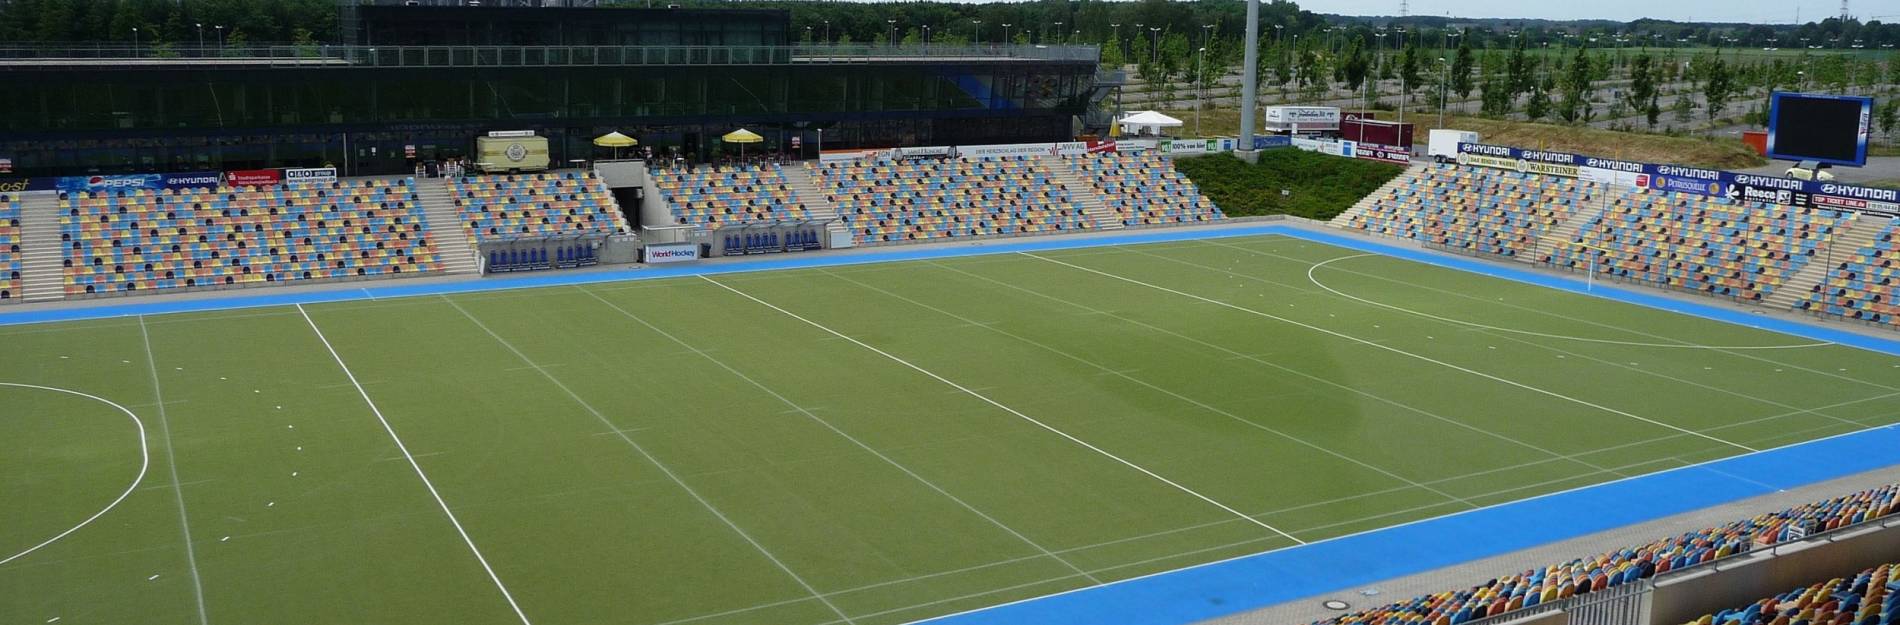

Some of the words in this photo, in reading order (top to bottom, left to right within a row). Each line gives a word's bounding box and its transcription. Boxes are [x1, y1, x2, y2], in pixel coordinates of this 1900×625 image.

[1472, 144, 1510, 156] HYUNDAI
[1533, 151, 1574, 163] HYUNDAI
[1529, 163, 1578, 176] WARSTEINER
[1598, 159, 1643, 173] HYUNDAI
[1671, 165, 1719, 180] HYUNDAI
[103, 178, 145, 188] PEPSI
[178, 176, 218, 185] HYUNDAI
[1750, 176, 1803, 190] HYUNDAI
[1744, 185, 1776, 199] Reece
[1837, 185, 1897, 201] HYUNDAI
